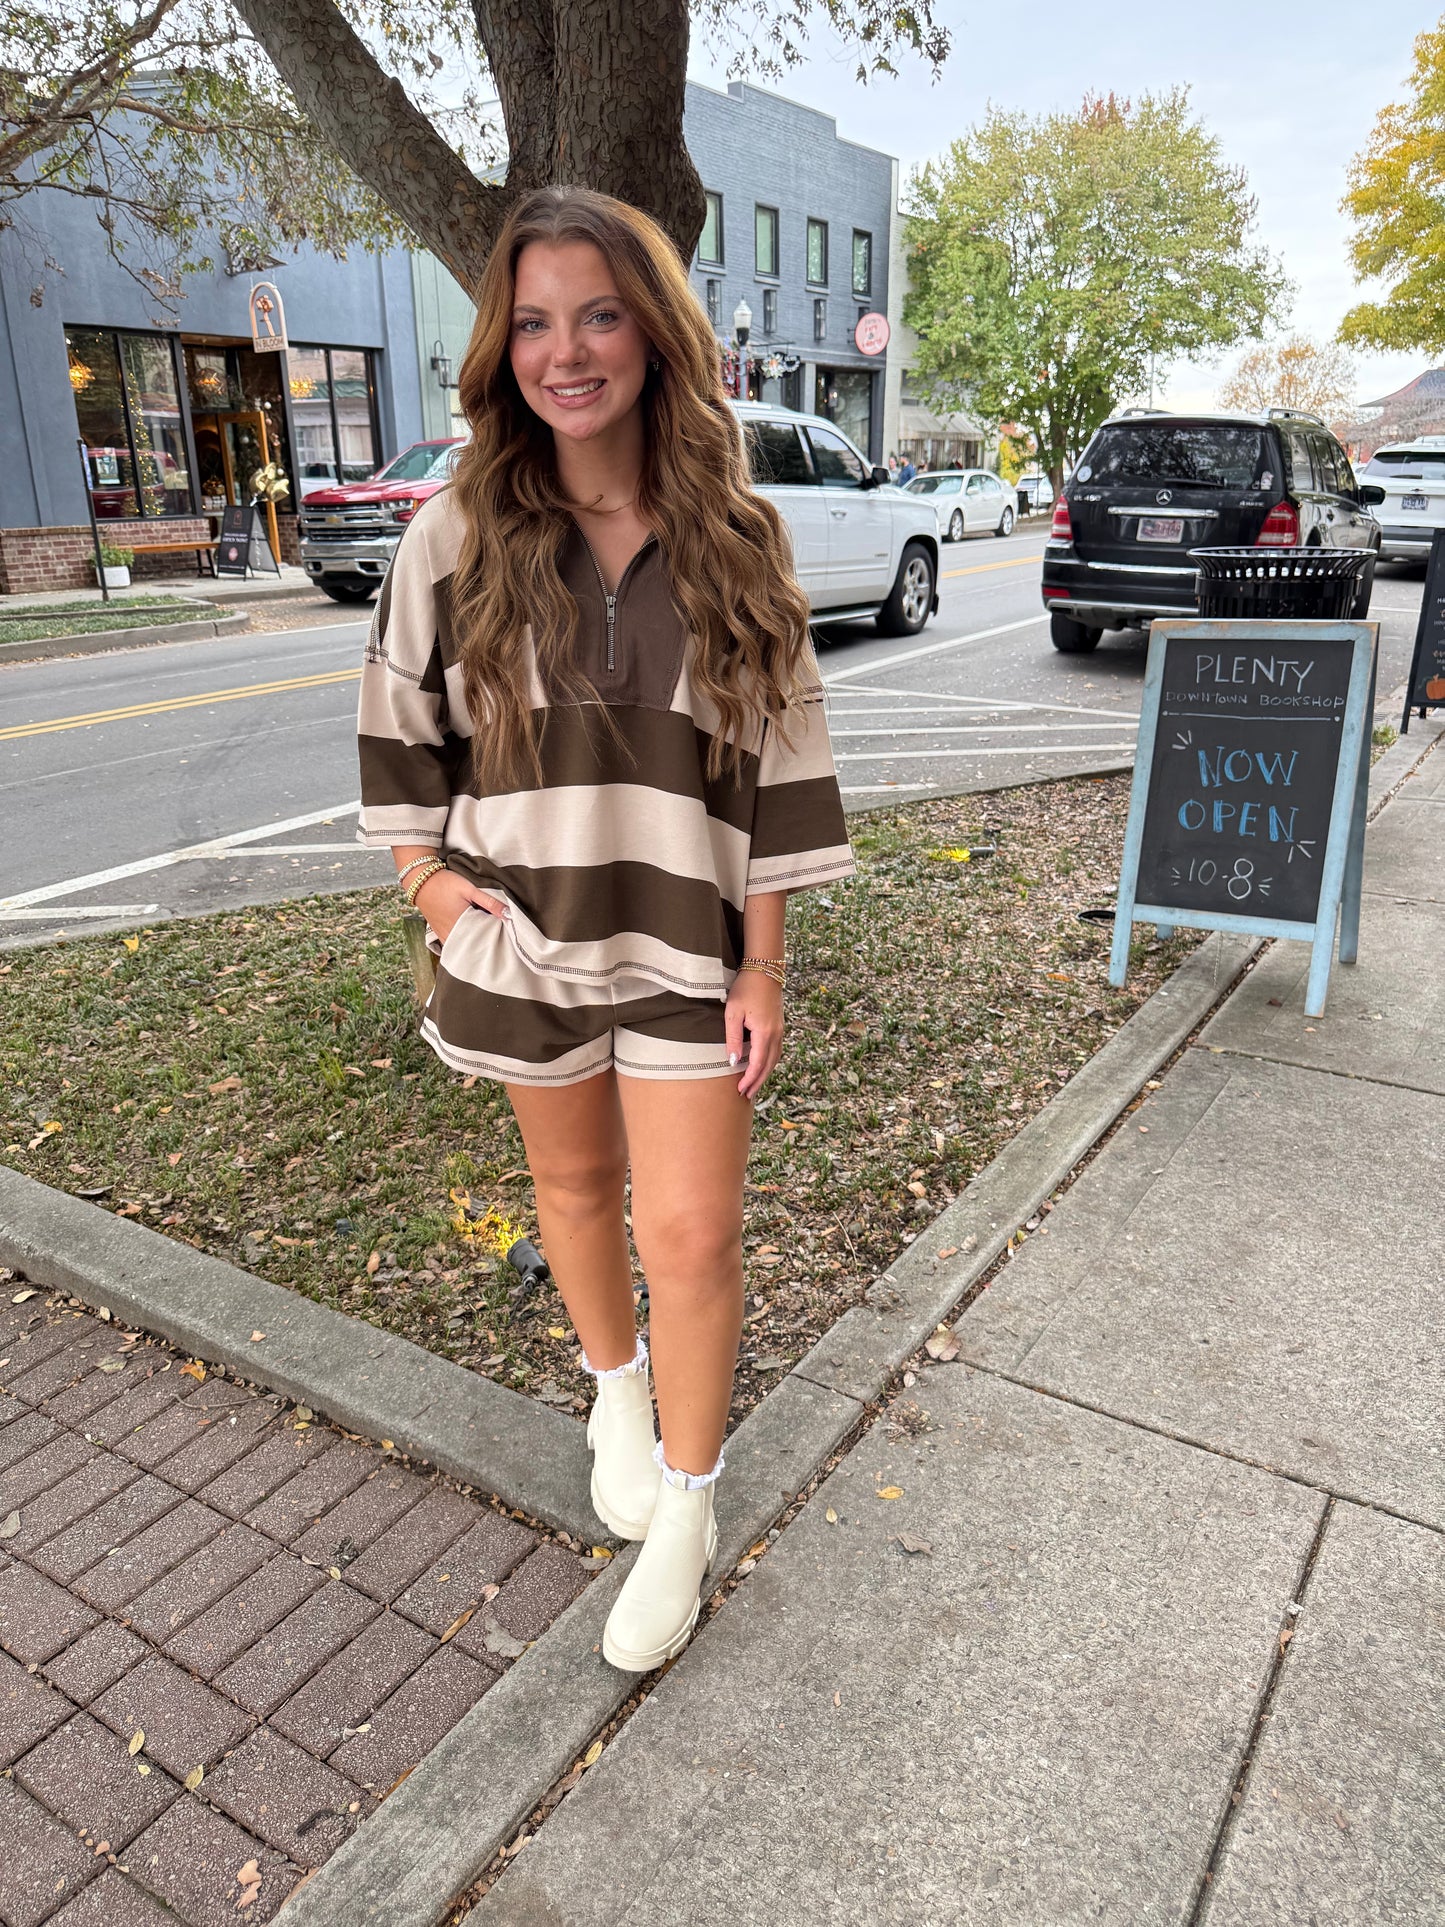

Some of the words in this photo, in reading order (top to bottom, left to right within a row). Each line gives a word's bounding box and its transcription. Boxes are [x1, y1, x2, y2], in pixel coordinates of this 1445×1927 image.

[263, 337, 284, 347] BLOOM
[1196, 654, 1314, 693] PLENTY
[1166, 691, 1248, 705] DOWNTOWN
[1259, 694, 1345, 709] BOOKSHOP
[1198, 746, 1299, 787] NOW
[1178, 799, 1299, 842] OPEN
